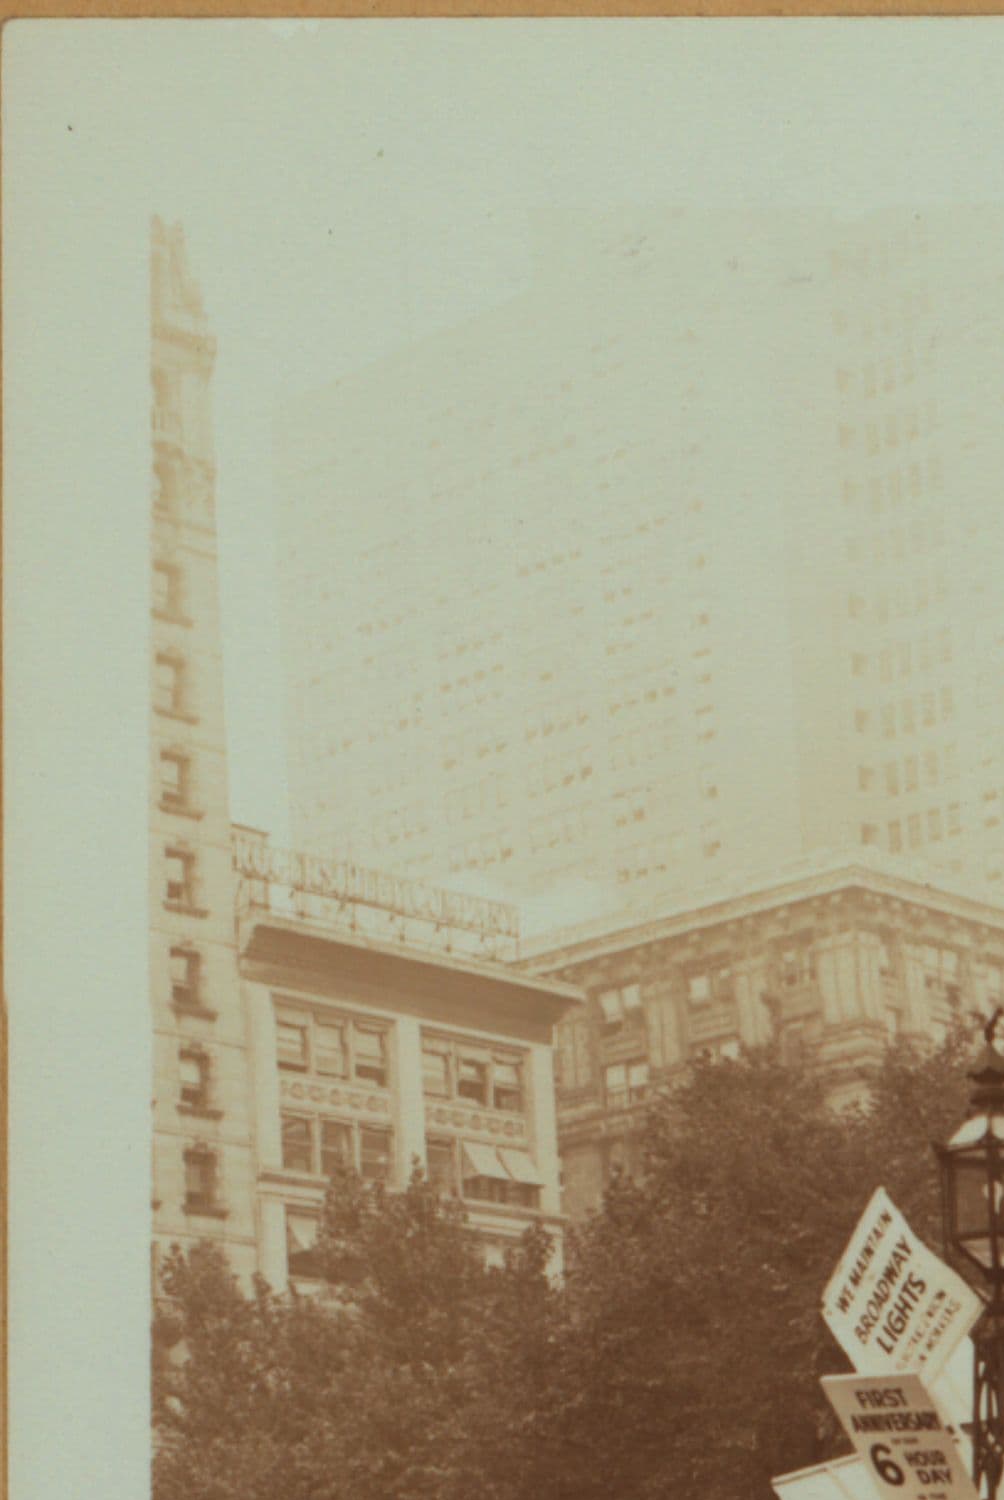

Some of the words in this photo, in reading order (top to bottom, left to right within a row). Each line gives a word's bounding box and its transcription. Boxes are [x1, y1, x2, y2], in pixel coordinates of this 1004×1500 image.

[836, 1283, 855, 1314] WE
[854, 1236, 912, 1344] BROADWAY
[876, 1272, 927, 1355] LIGHTS
[855, 1387, 907, 1408] FIRST
[870, 1443, 904, 1486] 6
[904, 1450, 946, 1467] HOUR
[916, 1469, 953, 1486] DAY
